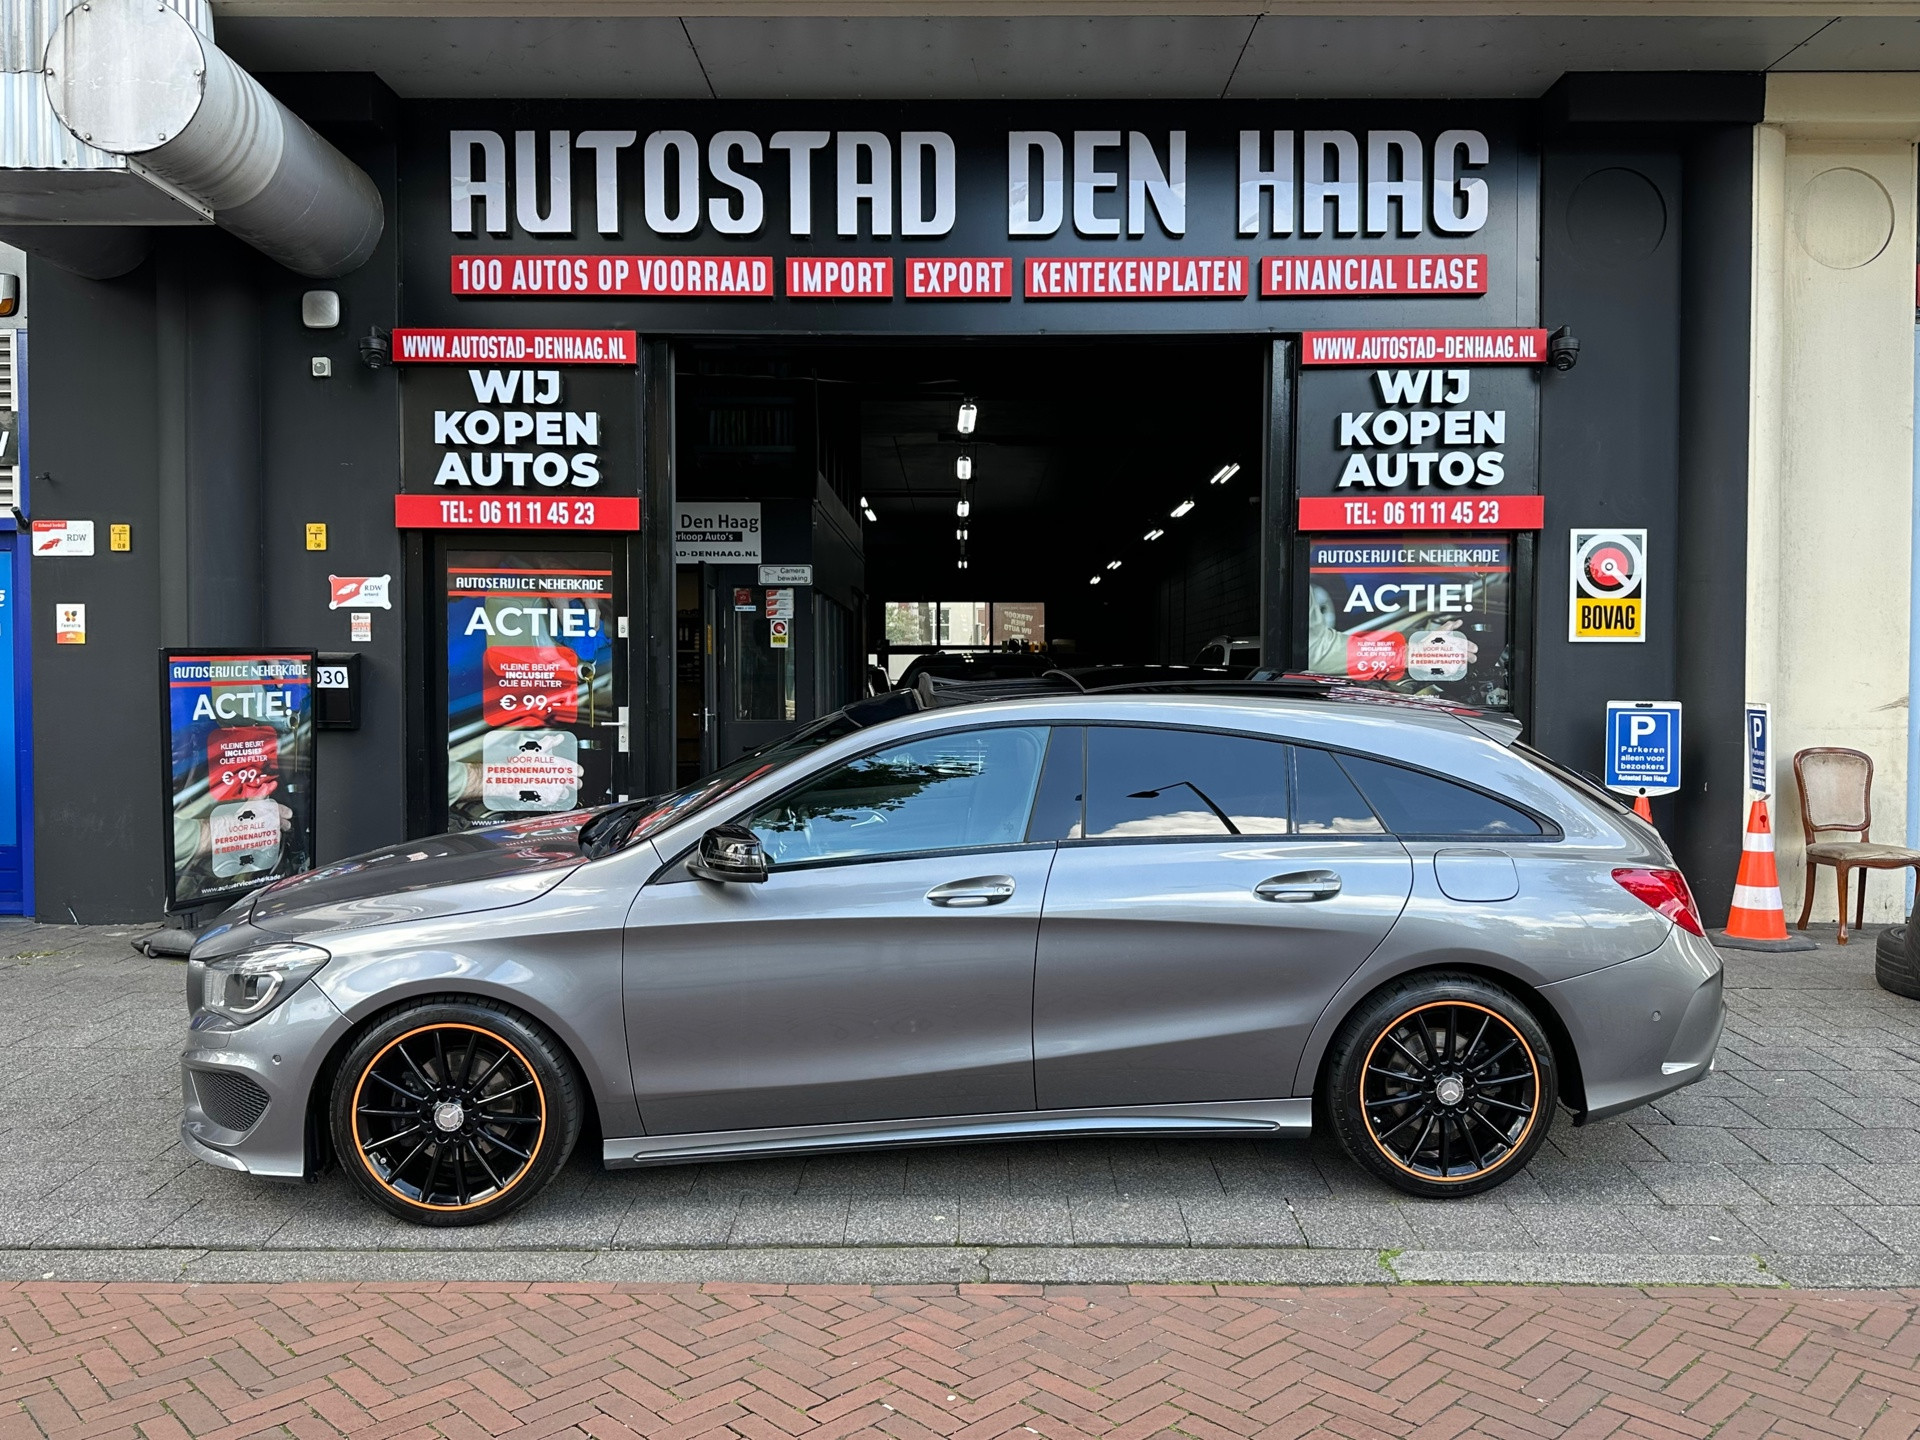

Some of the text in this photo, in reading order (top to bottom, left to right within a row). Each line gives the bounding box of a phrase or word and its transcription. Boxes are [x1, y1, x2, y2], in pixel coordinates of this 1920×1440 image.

[450, 129, 1489, 235] AUTOSTAD DEN HAAG
[459, 259, 766, 292] 100 AUTOS OP VOORRAAD
[793, 261, 886, 293] IMPORT
[913, 262, 1004, 293] EXPORT
[1032, 260, 1243, 293] KENTEKENPLATEN
[1271, 258, 1479, 291] FINANCIAL LEASE
[402, 336, 627, 360] WWW.AUTOSTAD-DENHAAG.NL
[1313, 336, 1537, 360] WWW.AUTOSTAD-DENHAAG.NL
[468, 370, 560, 405] WIJ
[1377, 370, 1470, 404] WIJ
[434, 410, 599, 446] KOPEN
[1341, 410, 1506, 446] KOPEN
[434, 452, 600, 487] AUTOS
[1339, 452, 1505, 487] AUTOS
[440, 501, 595, 525] TEL: 06 11 11 45 23
[681, 514, 759, 532] Den Haag
[1344, 501, 1499, 525] TEL: 06 11 11 45 23
[705, 532, 733, 541] Auto's
[1318, 549, 1500, 563] AUTOSERVICE NEHERKADE
[456, 577, 604, 591] AUTOSERVICE NEHERKADE
[777, 575, 807, 583] bewaking
[1343, 584, 1473, 613] ACTIE!
[464, 607, 597, 637] ACTIE!
[1581, 605, 1635, 630] BOVAG
[173, 664, 307, 679] AUTOSERVICE NEHERKADE
[500, 663, 530, 671] KLEINE
[1357, 661, 1395, 672] € 99,-
[534, 680, 562, 688] FILTER
[192, 691, 292, 721] ACTIE!
[499, 694, 561, 713] € 99,-
[1630, 716, 1656, 746] P
[1753, 717, 1762, 749] P
[225, 748, 263, 757] INCLUSIEF
[245, 740, 264, 748] BEURT
[247, 755, 268, 763] FILTER
[487, 766, 573, 774] PERSONENAUTO'S
[507, 756, 532, 764] VOOR
[222, 769, 267, 785] € 99,-
[495, 777, 575, 785] BEDRIJFSAUTO'S
[1653, 775, 1667, 783] Haag
[215, 829, 277, 845] PERSONENAUTO'S
[228, 822, 265, 833] VOOR ALLE
